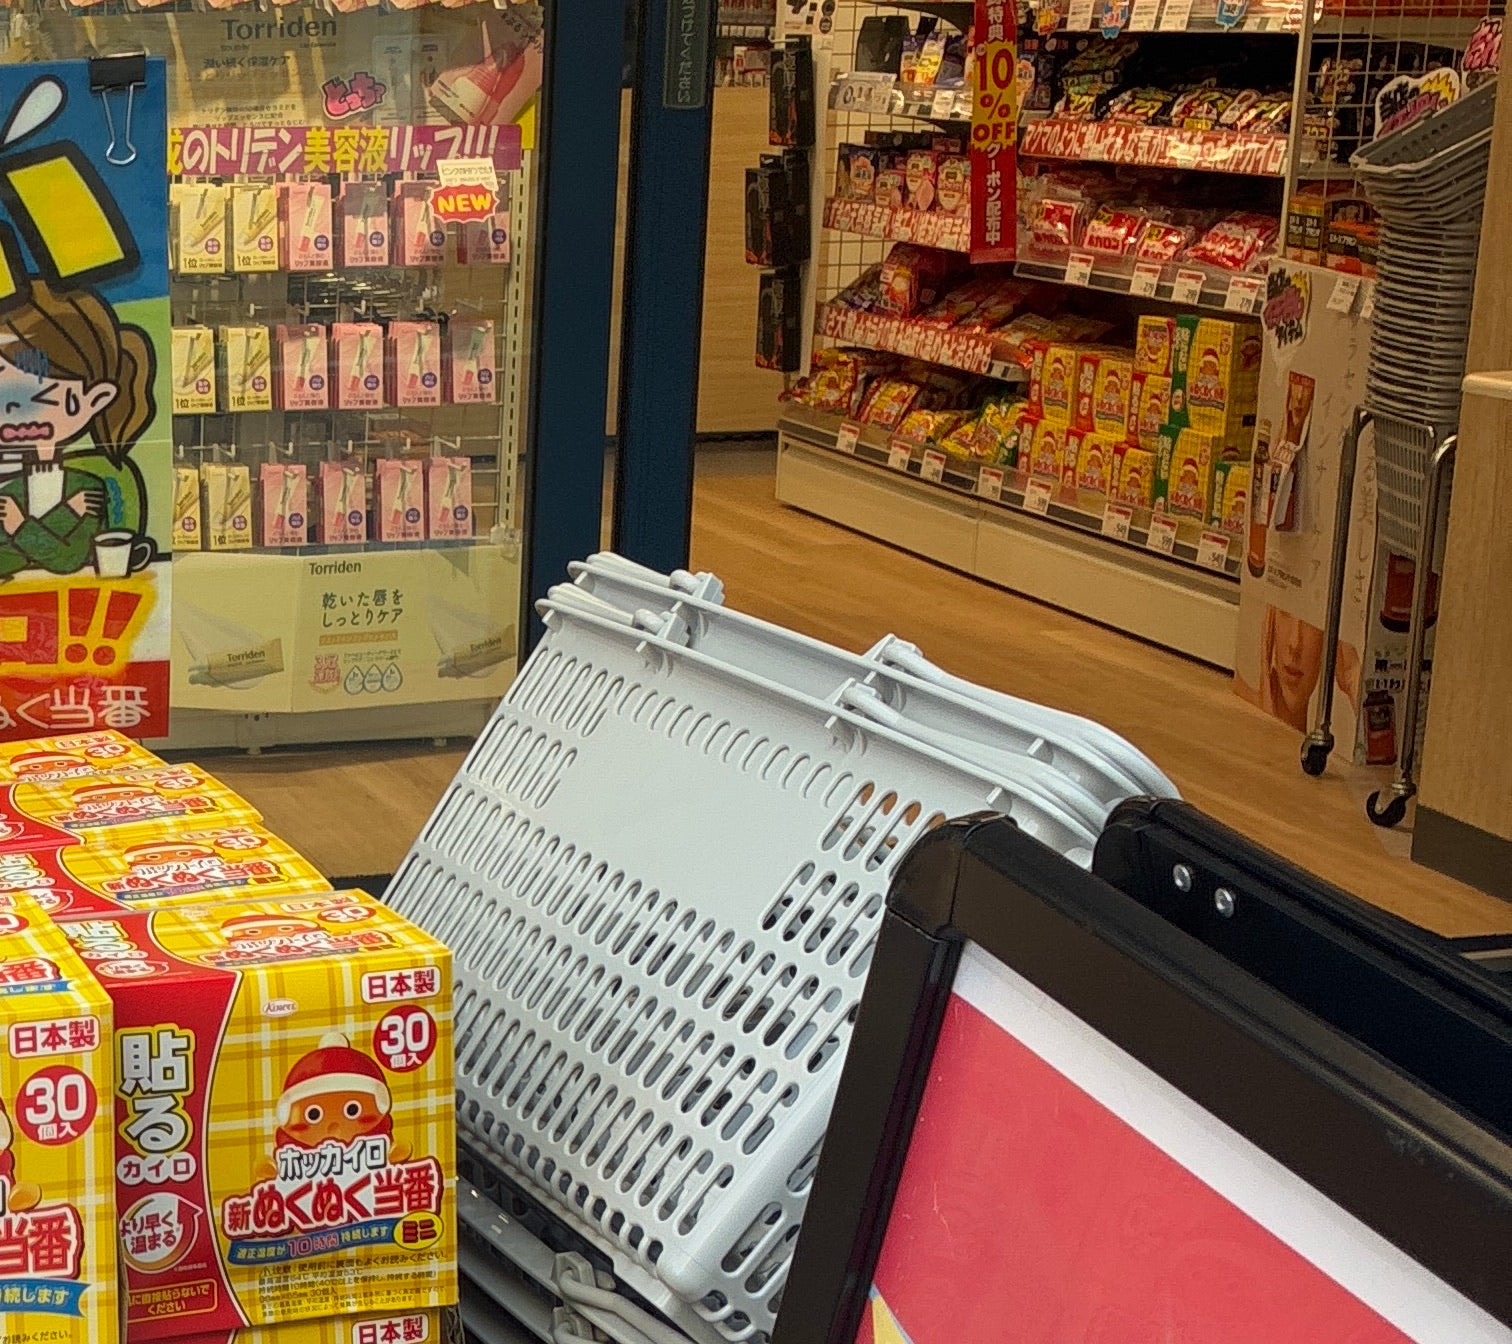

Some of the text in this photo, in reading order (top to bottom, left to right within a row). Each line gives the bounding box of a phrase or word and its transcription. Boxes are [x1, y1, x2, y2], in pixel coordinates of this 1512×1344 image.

[221, 17, 337, 41] Torriden
[977, 49, 1014, 91] 10
[973, 122, 1015, 142] OFF
[438, 193, 492, 213] NEW
[310, 560, 362, 576] Torriden
[323, 589, 404, 610] 乾いた唇を
[323, 608, 404, 628] しっとりケア
[366, 968, 437, 1000] 日本製
[119, 1030, 194, 1155] 貼る
[279, 1136, 386, 1179] ホッカイロ
[122, 1160, 192, 1182] カイロ
[226, 1163, 439, 1238] 新ぬくぬく当番
[401, 1218, 437, 1244] ミニ
